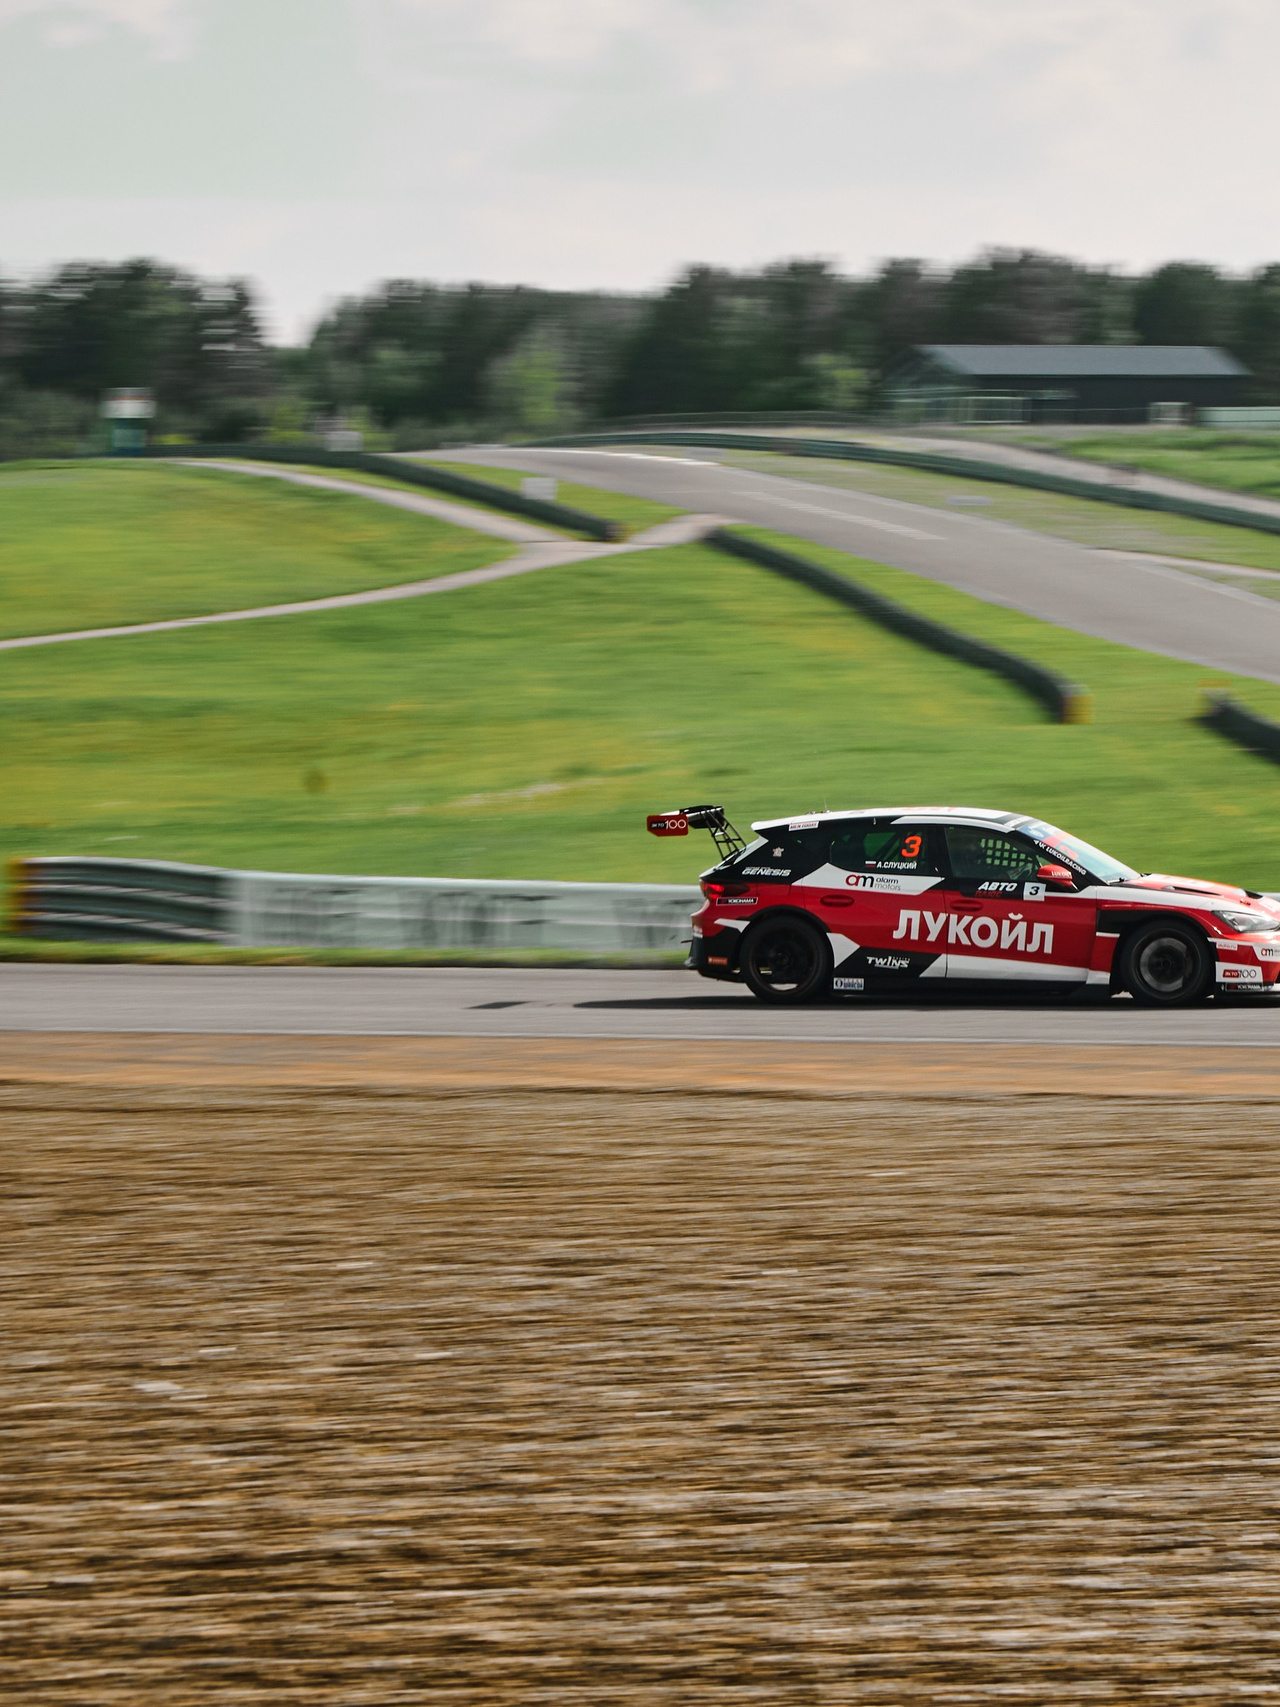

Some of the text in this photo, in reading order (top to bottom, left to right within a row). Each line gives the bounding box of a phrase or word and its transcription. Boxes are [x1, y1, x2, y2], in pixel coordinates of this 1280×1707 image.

[665, 818, 687, 830] 100
[901, 835, 922, 858] 3
[876, 860, 918, 870] А.СЛУЦКИЙ
[741, 867, 792, 877] GENESIS
[875, 876, 899, 884] alarm
[874, 882, 901, 891] motors
[978, 881, 1018, 892] АВТО
[1029, 885, 1040, 896] 3
[892, 909, 1055, 954] ЛУКОЙЛ
[866, 955, 910, 969] TWINS
[1238, 968, 1257, 979] 100
